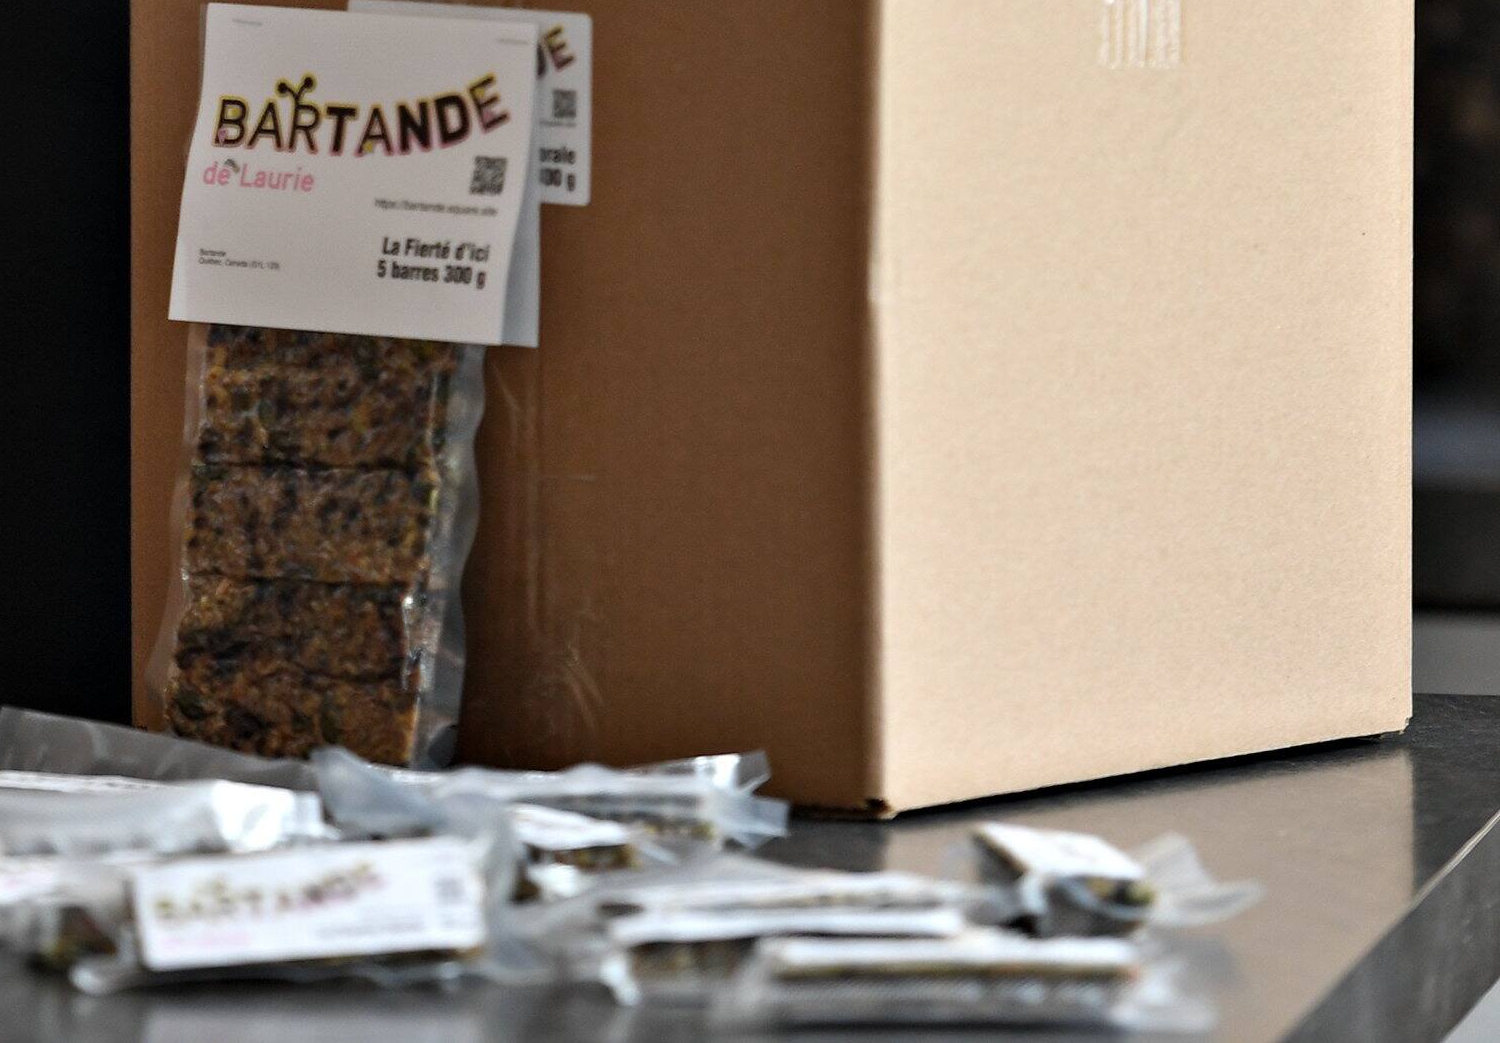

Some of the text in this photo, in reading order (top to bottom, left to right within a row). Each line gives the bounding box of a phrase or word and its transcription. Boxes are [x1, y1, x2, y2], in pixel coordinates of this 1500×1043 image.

[213, 72, 511, 158] BARTANDE
[203, 162, 315, 192] de Laurie
[382, 237, 400, 256] La
[405, 238, 450, 260] Fierté
[377, 259, 386, 278] 5
[391, 261, 439, 282] barres
[443, 265, 472, 284] 300
